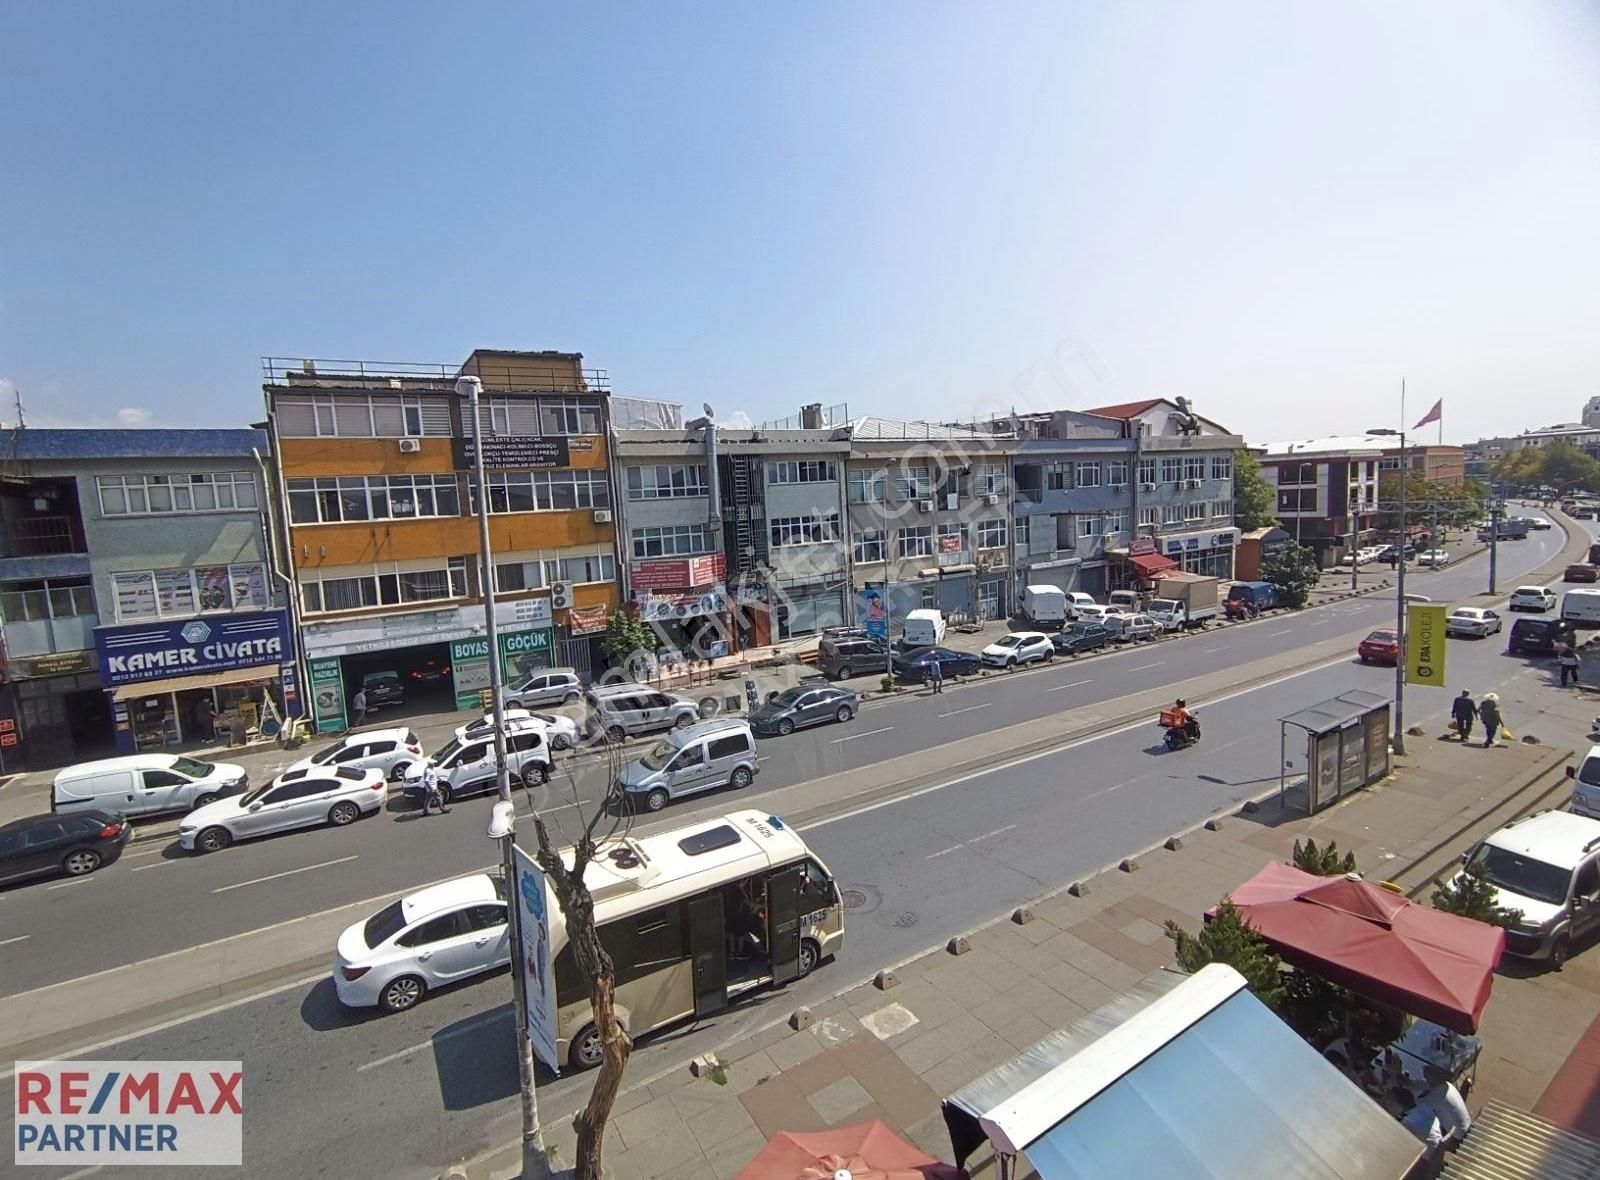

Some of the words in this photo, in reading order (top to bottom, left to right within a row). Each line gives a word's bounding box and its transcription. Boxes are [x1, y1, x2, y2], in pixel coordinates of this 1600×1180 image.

[506, 632, 547, 652] GÖÇÜK
[108, 648, 198, 674] KAMER
[204, 637, 281, 659] CİVATA
[809, 911, 826, 924] 1625
